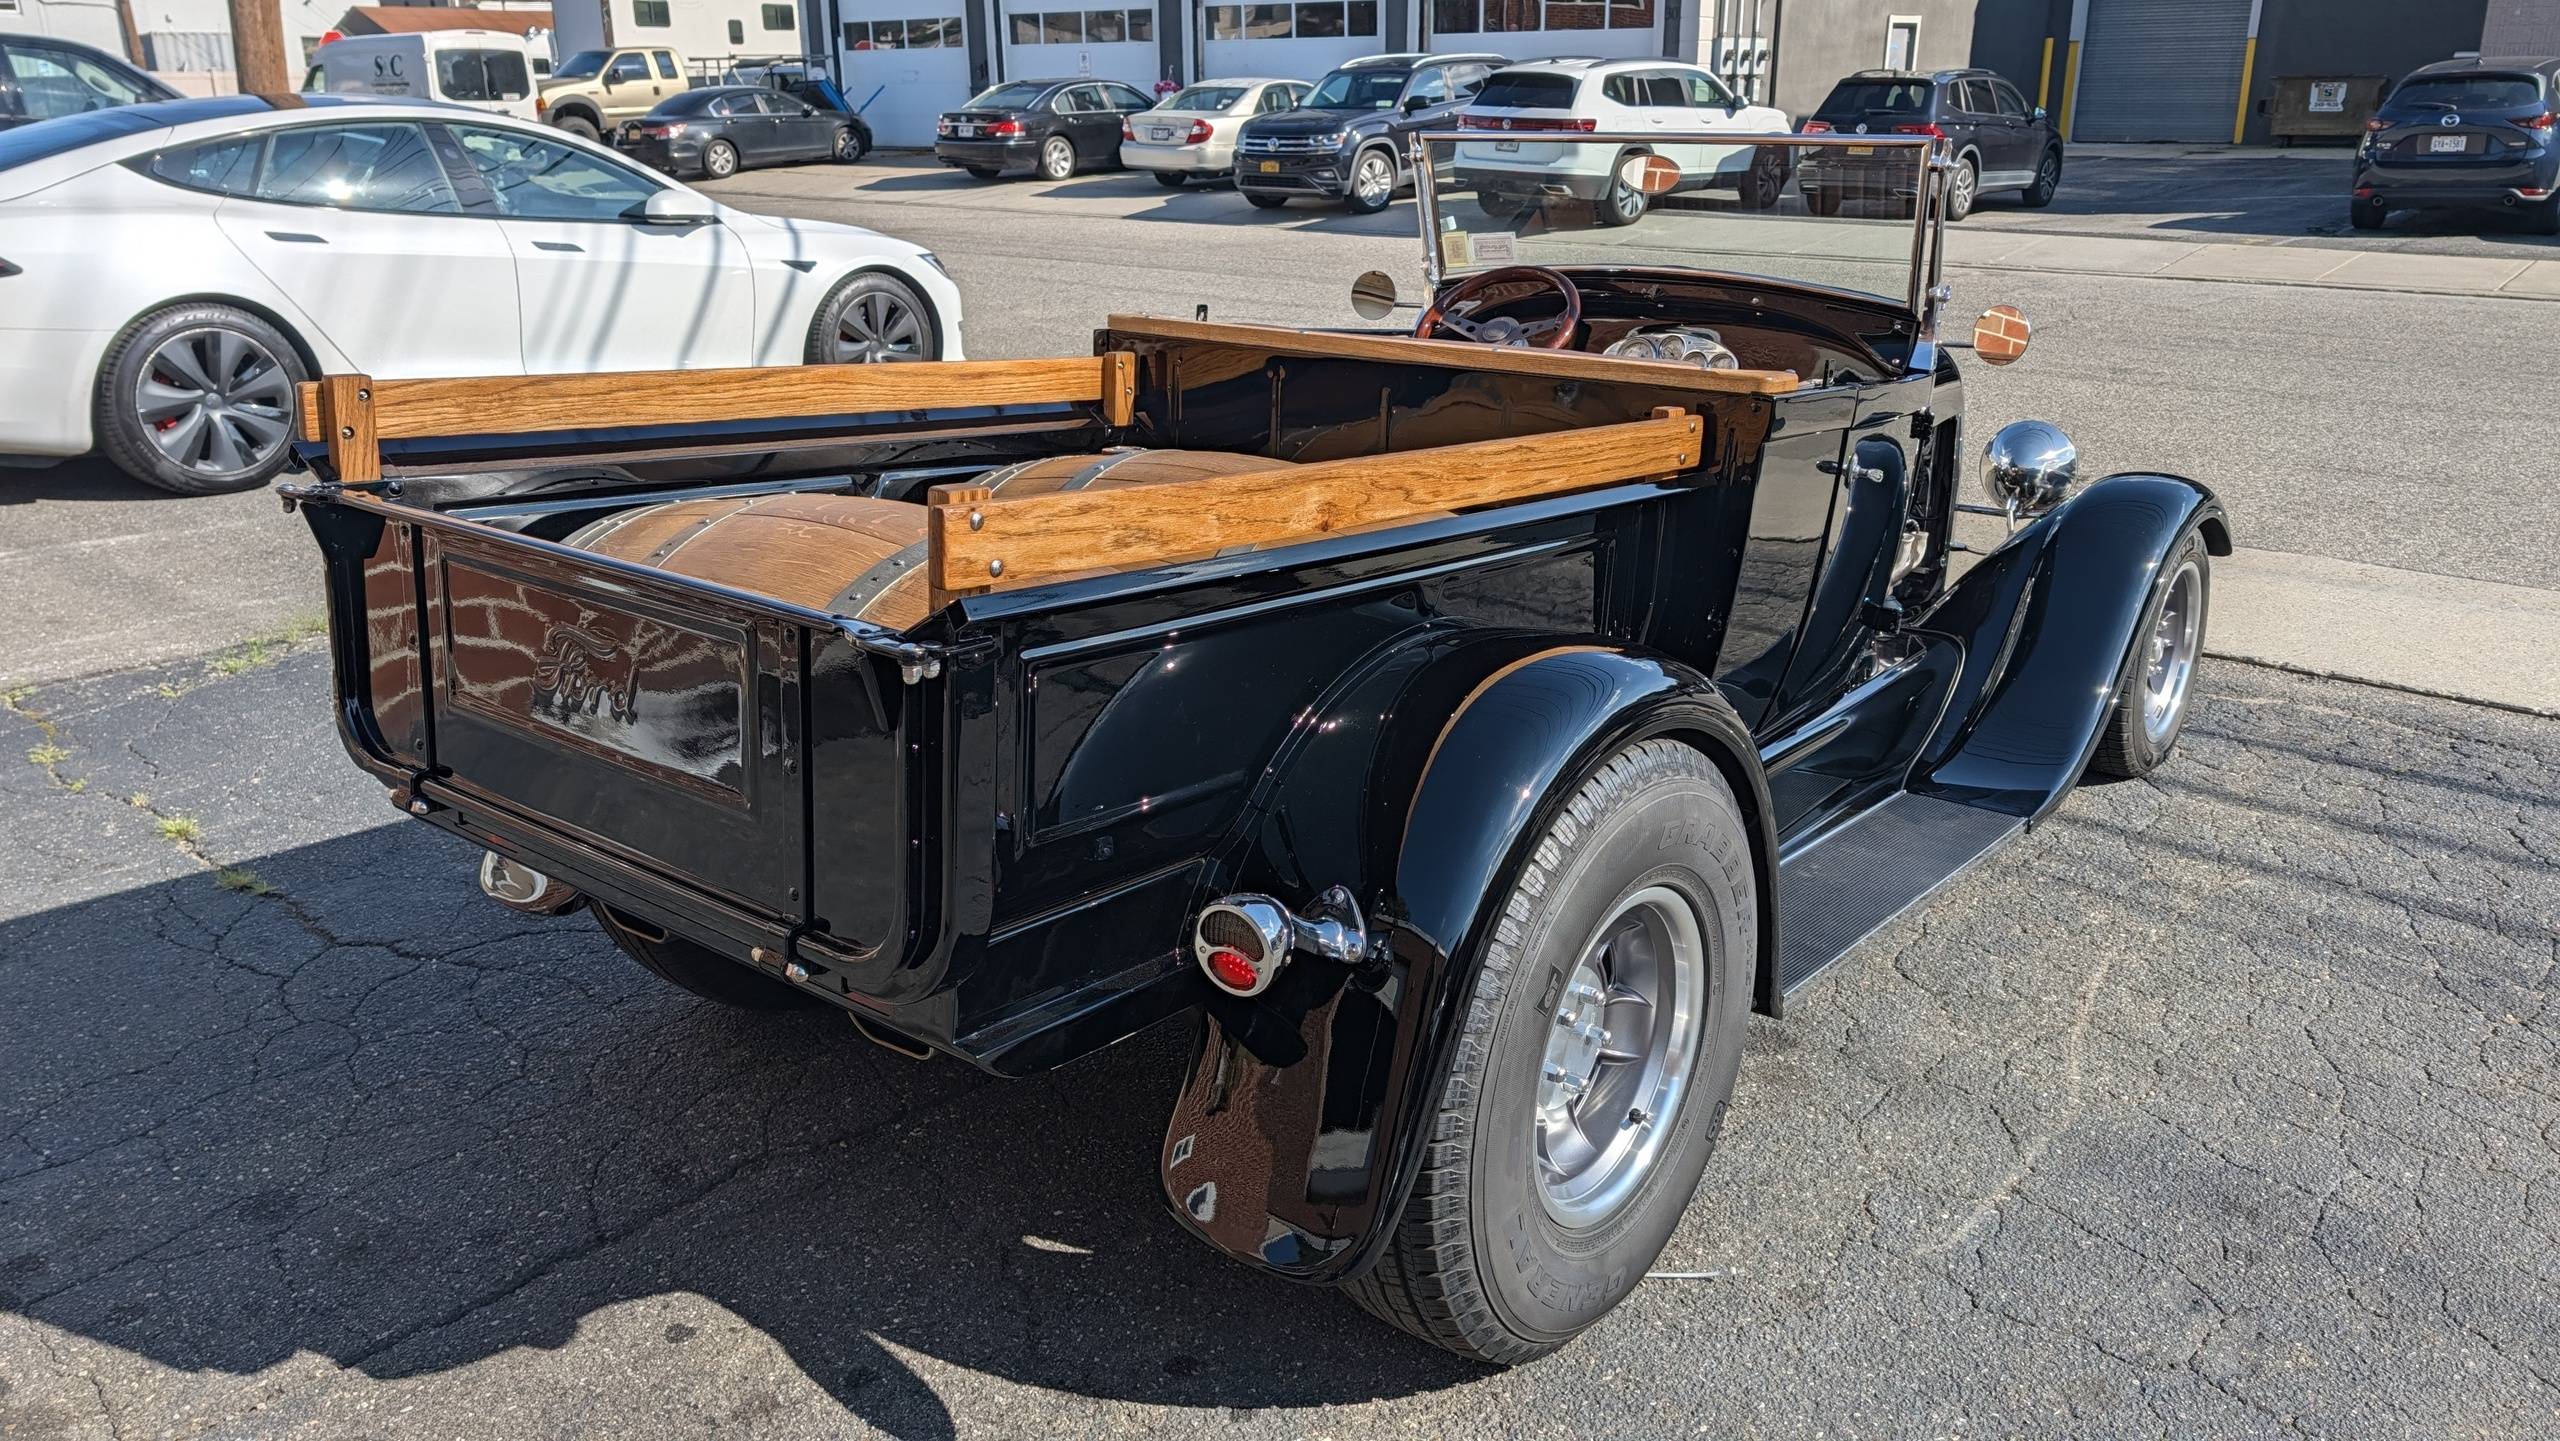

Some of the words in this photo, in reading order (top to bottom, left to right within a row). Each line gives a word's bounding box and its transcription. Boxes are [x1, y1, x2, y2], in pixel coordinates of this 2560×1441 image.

[534, 624, 639, 724] Ford
[1658, 817, 1753, 936] GRABBER
[1508, 1211, 1628, 1313] GENERAL
